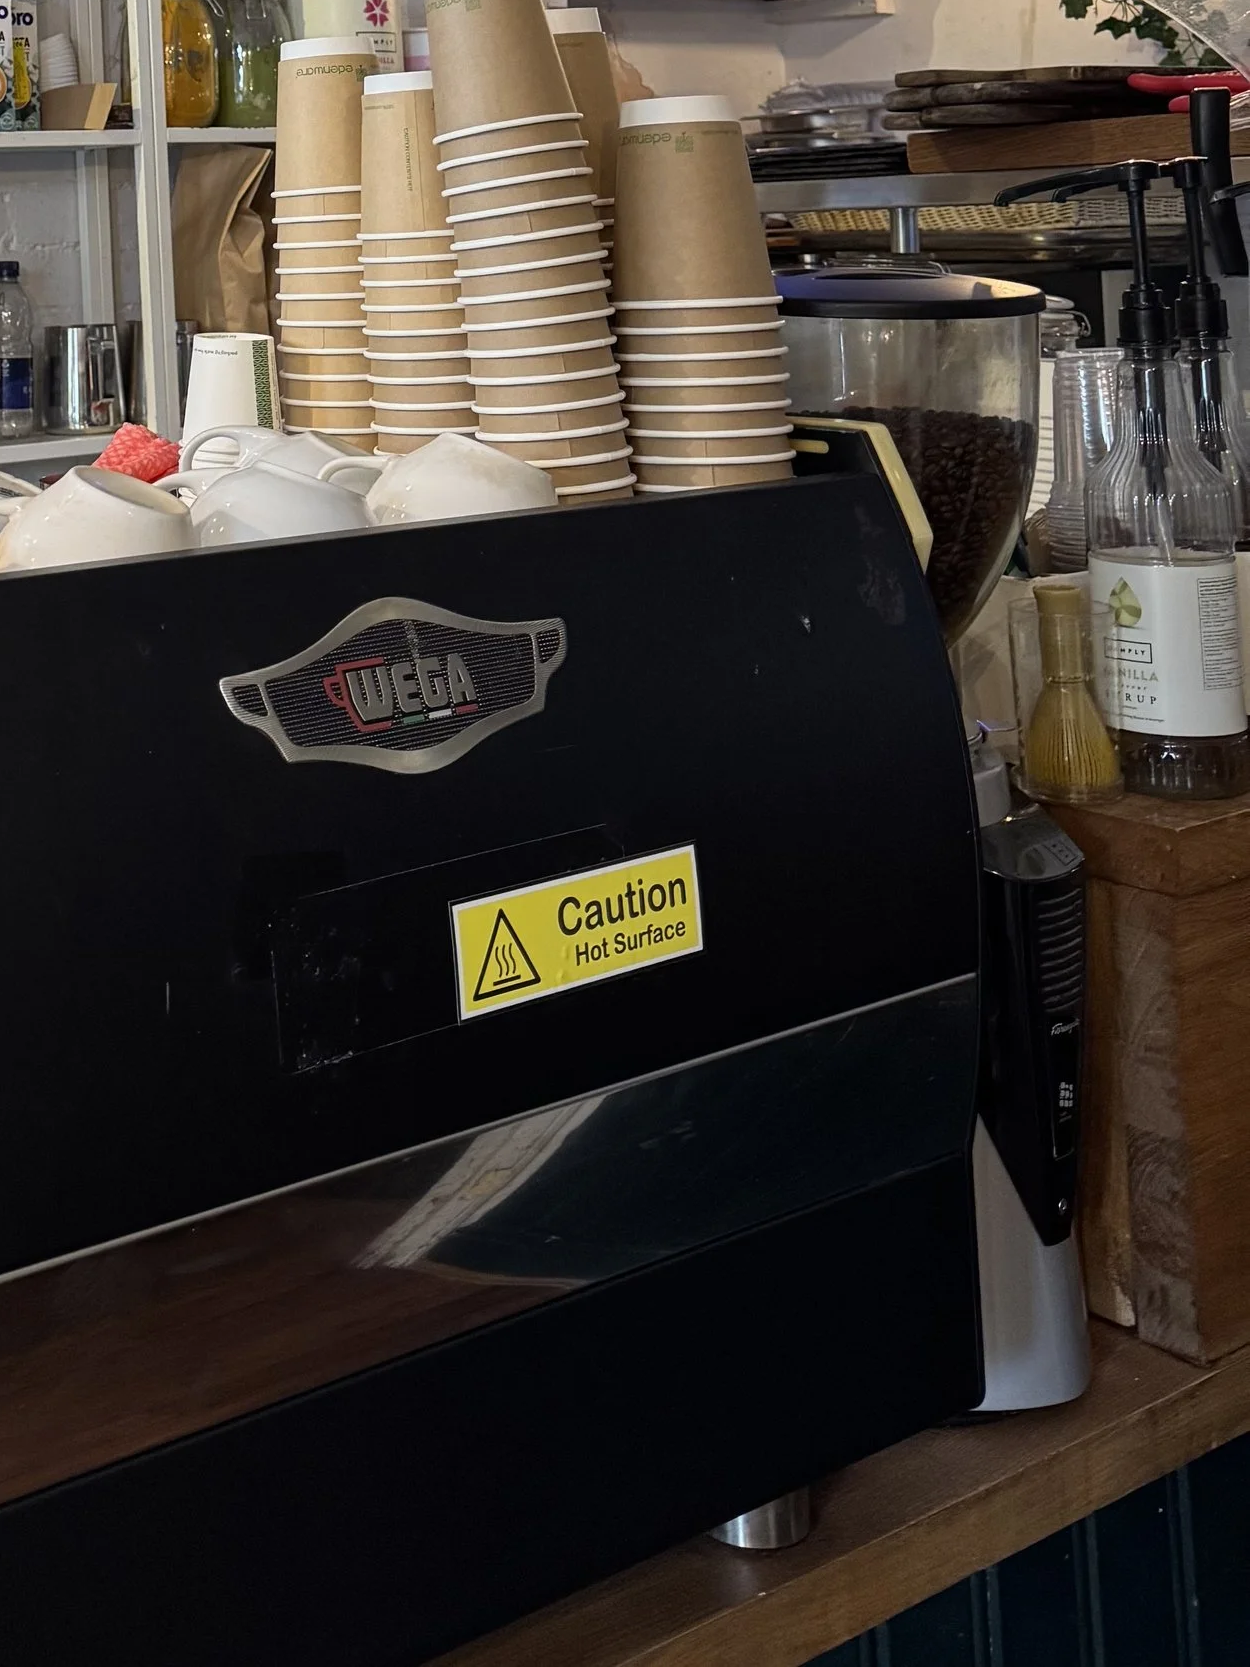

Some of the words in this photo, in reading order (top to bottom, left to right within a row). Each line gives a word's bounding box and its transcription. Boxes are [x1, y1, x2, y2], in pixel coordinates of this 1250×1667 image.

[296, 64, 354, 79] edenware
[345, 652, 478, 722] WEGA
[557, 876, 687, 937] Caution
[575, 942, 609, 967] Hot
[614, 919, 687, 956] Surface
